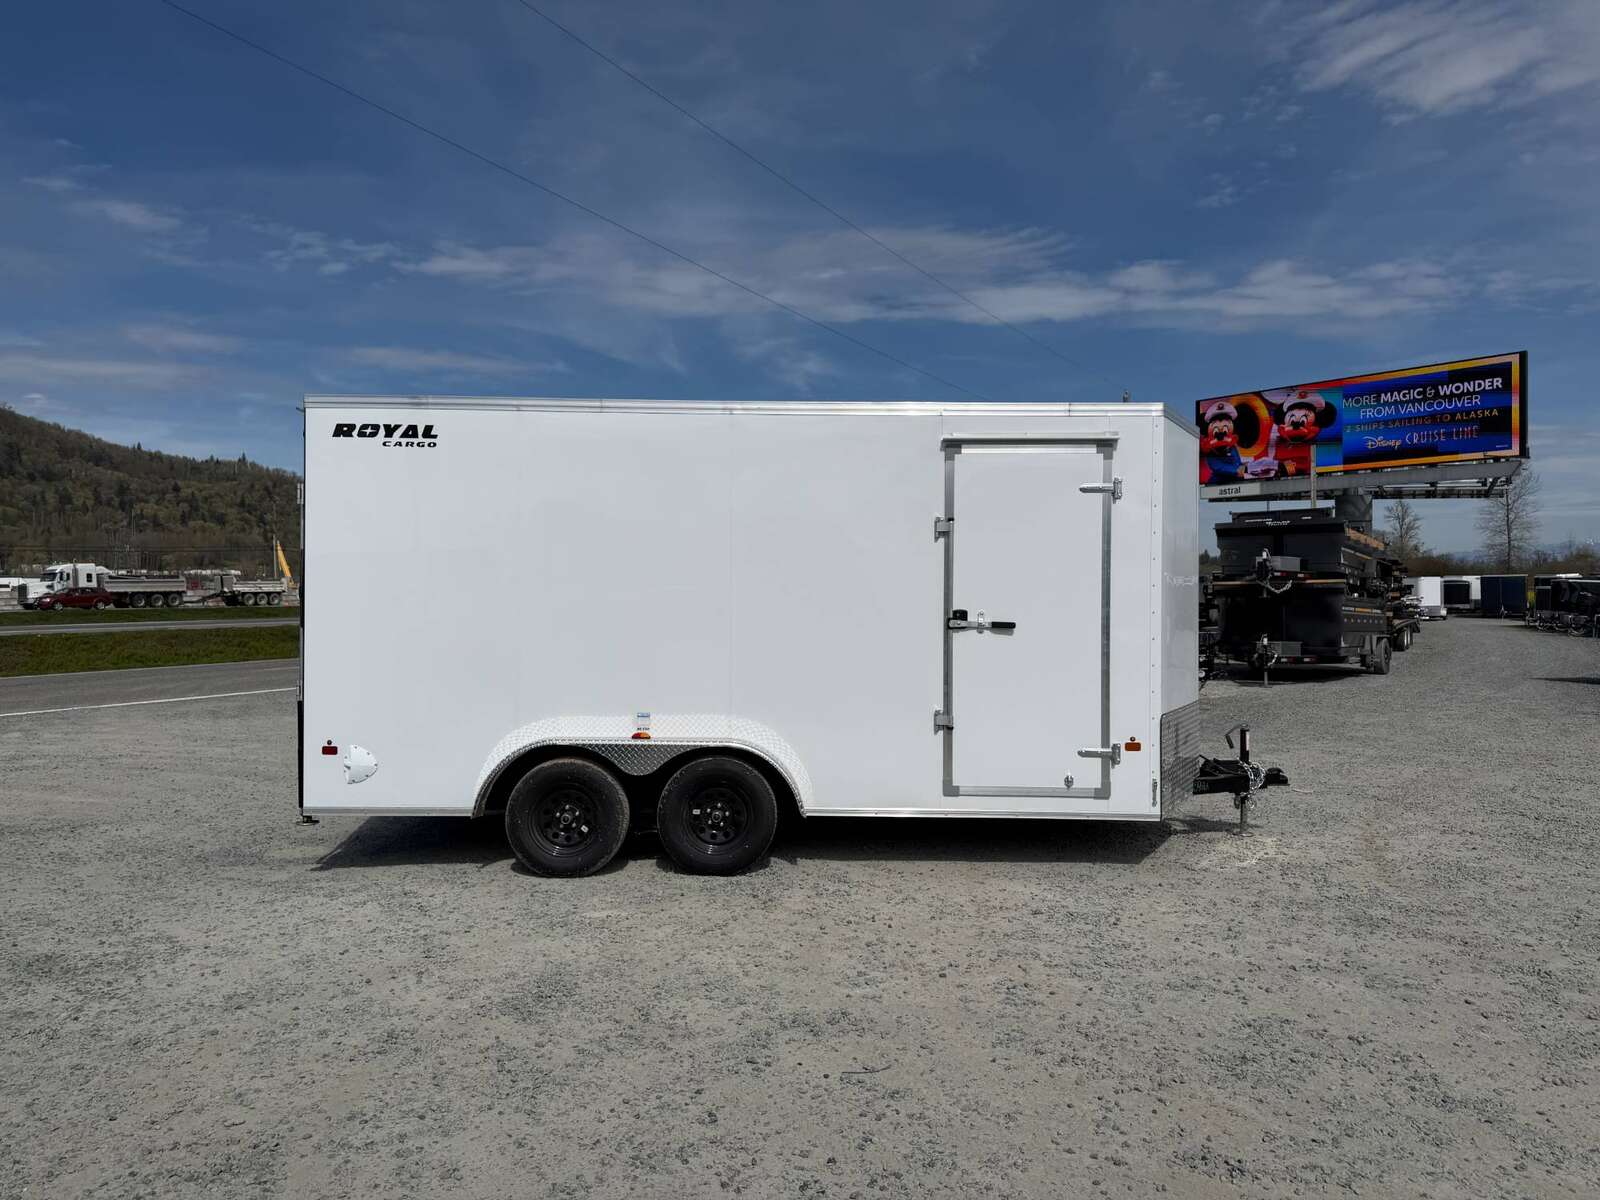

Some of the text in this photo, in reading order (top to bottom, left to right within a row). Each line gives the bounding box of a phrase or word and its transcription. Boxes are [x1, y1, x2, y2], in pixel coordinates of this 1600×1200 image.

[1343, 377, 1503, 408] MORE MAGIC & WONDER
[1360, 394, 1481, 419] FROM VANCOUVER
[332, 423, 438, 439] ROYAL
[1354, 421, 1385, 432] SHIPS
[1387, 416, 1432, 429] SAILING
[1435, 413, 1451, 423] TO
[1455, 408, 1499, 421] ALASKA
[1361, 425, 1480, 450] Disney CRUISE LINE
[1218, 486, 1241, 496] astral
